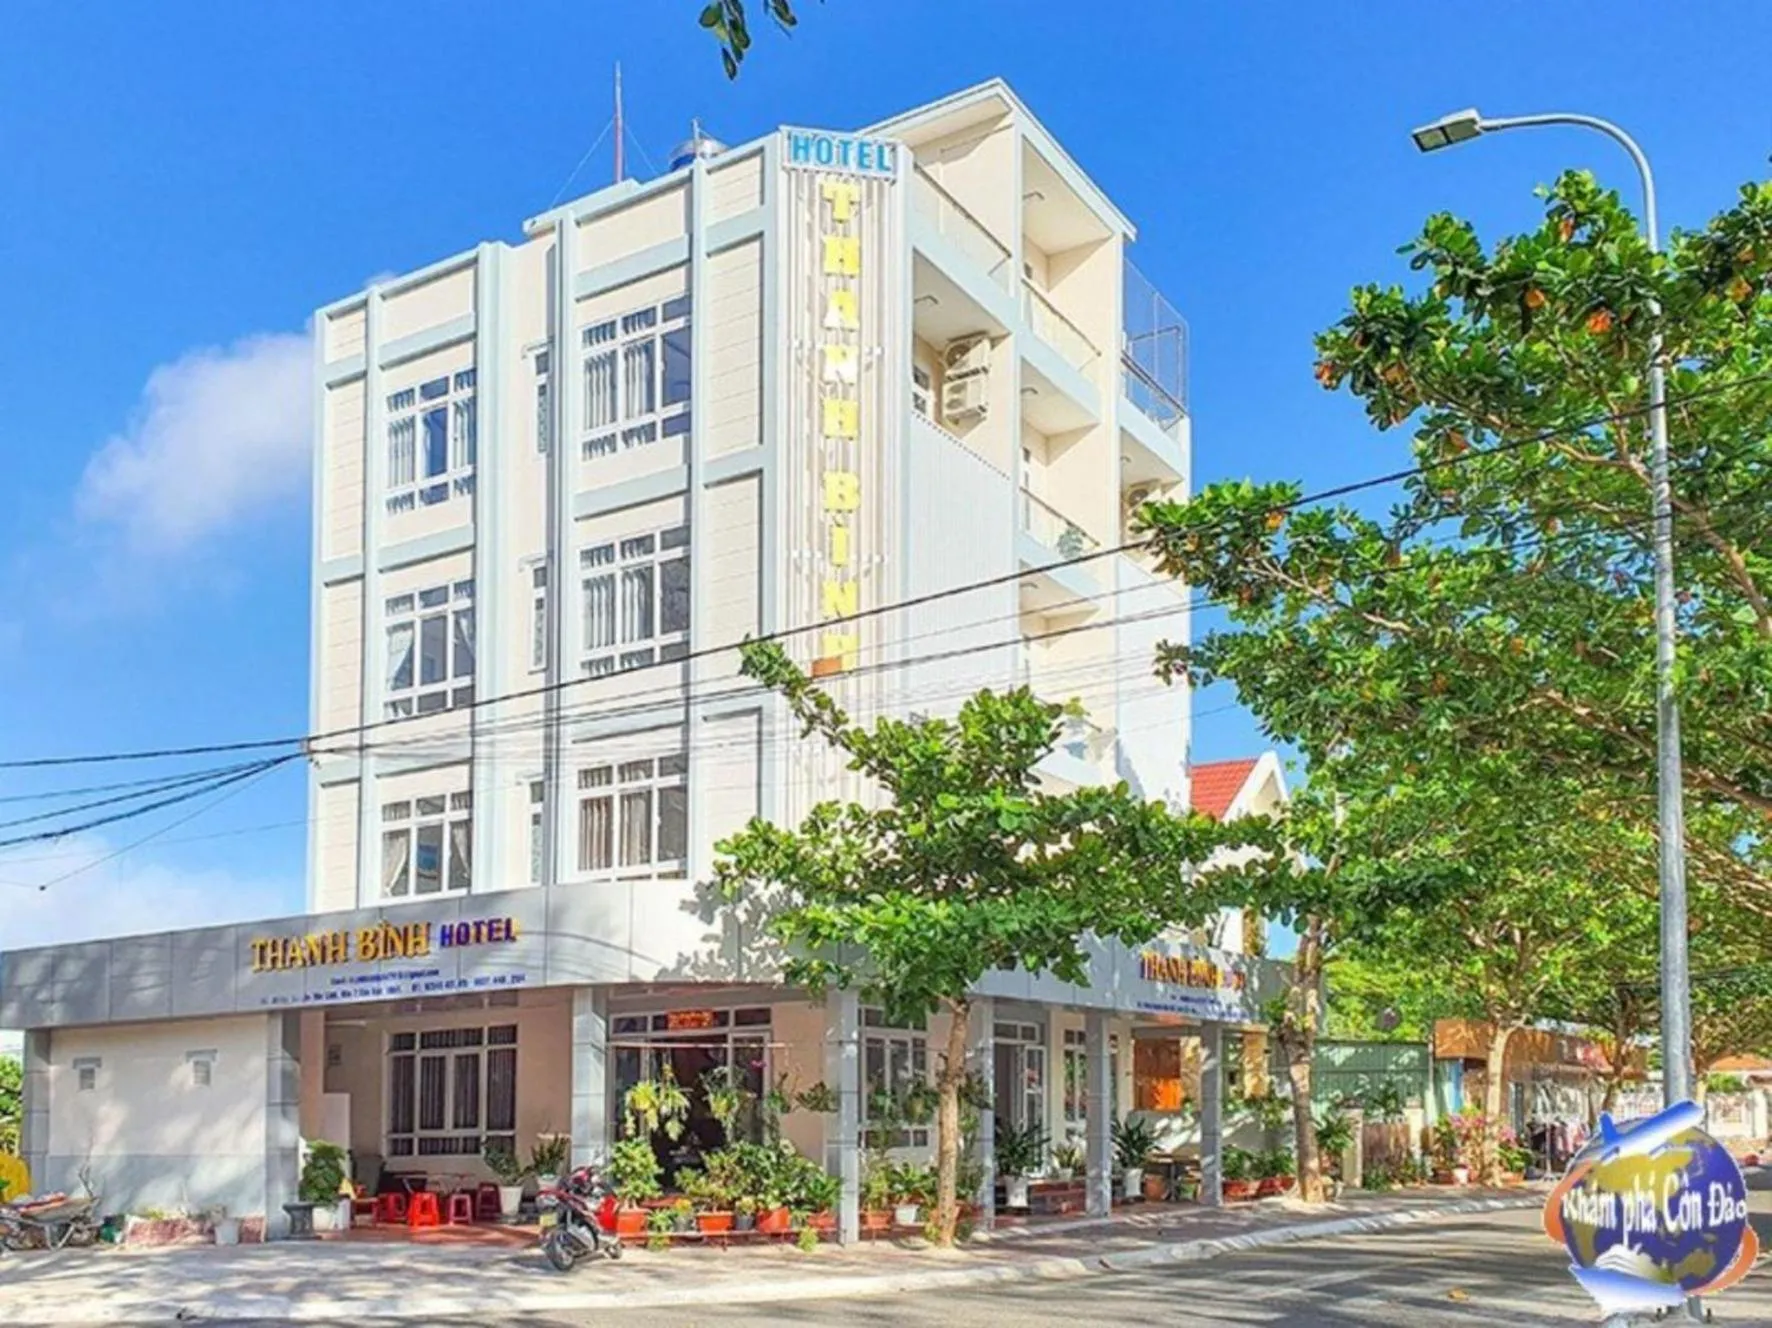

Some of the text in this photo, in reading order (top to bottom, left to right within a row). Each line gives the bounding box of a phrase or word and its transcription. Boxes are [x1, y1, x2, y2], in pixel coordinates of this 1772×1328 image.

[793, 134, 891, 172] HOTEL
[821, 181, 860, 440] THANH
[251, 917, 517, 973] THANH BÌNH HOTEL
